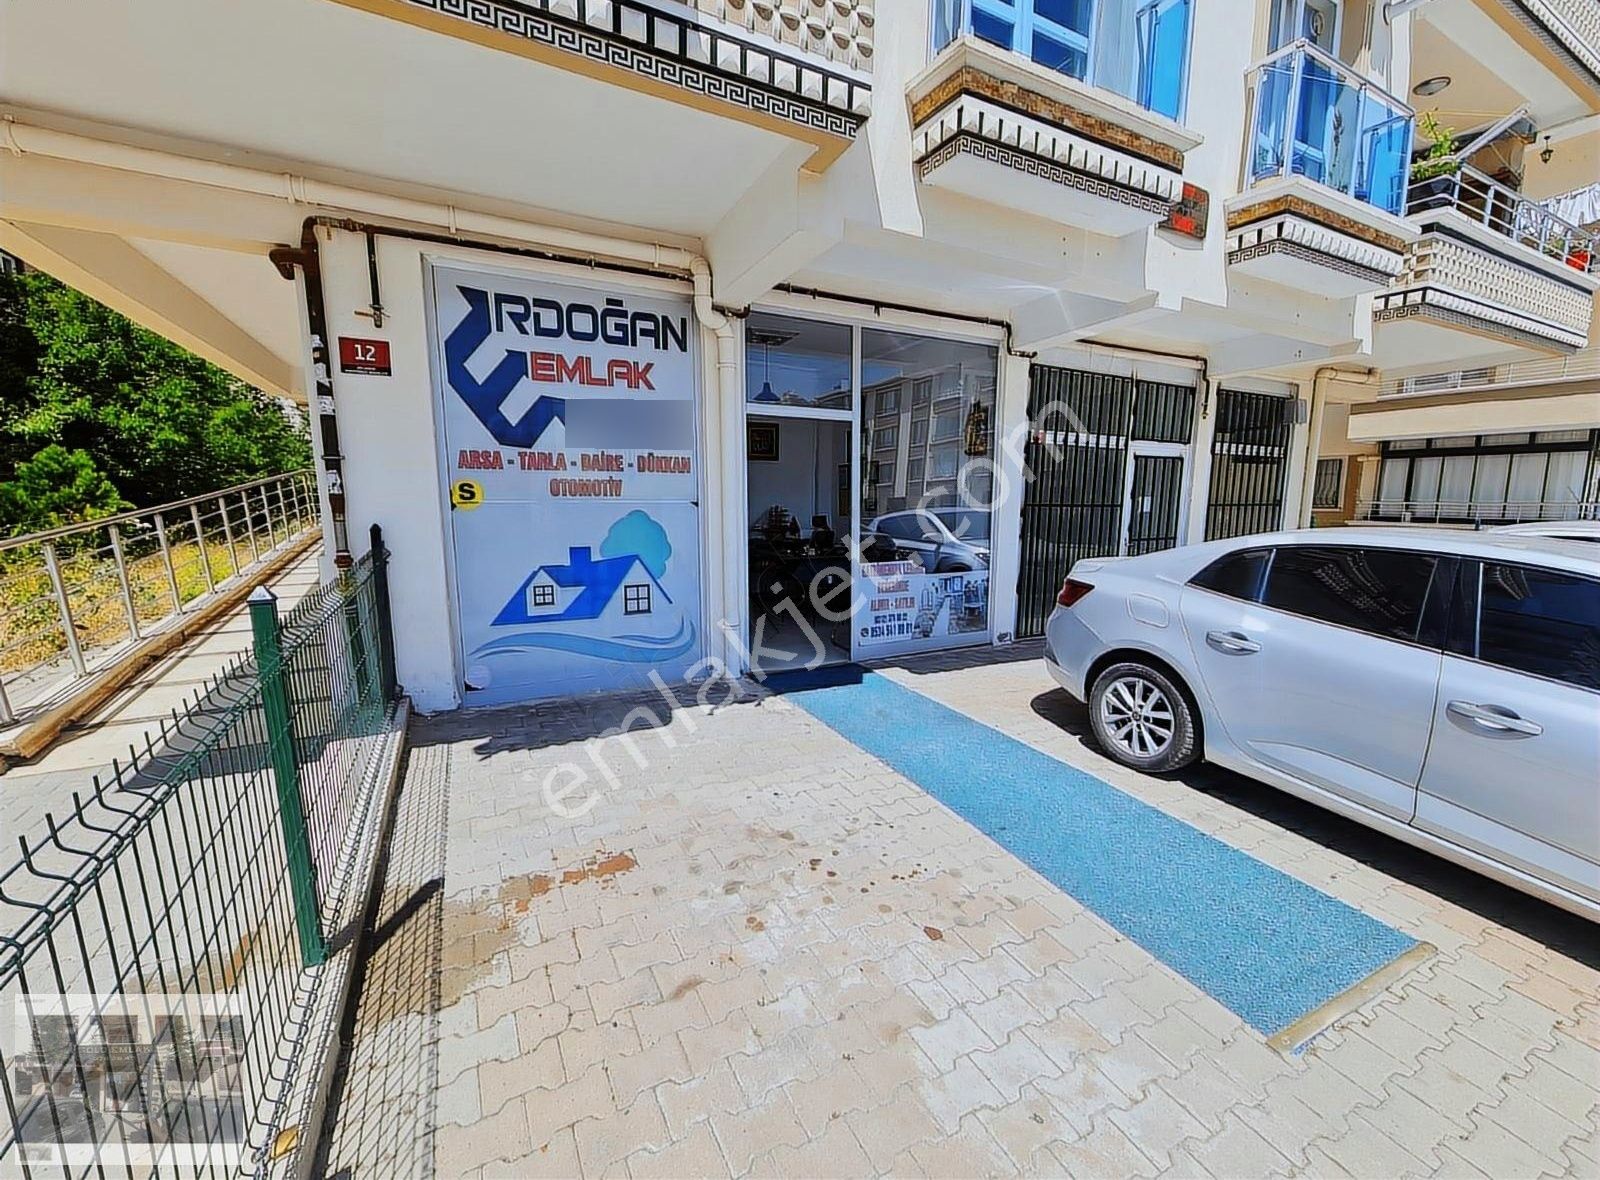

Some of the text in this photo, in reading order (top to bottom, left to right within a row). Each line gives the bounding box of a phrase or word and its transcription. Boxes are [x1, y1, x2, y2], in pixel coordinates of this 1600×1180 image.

[354, 344, 376, 361] 12
[530, 351, 655, 390] EMLAK
[458, 450, 503, 470] ARSA
[518, 452, 567, 471] TARLA
[458, 482, 476, 501] S
[550, 476, 623, 497] OTOMOTİV
